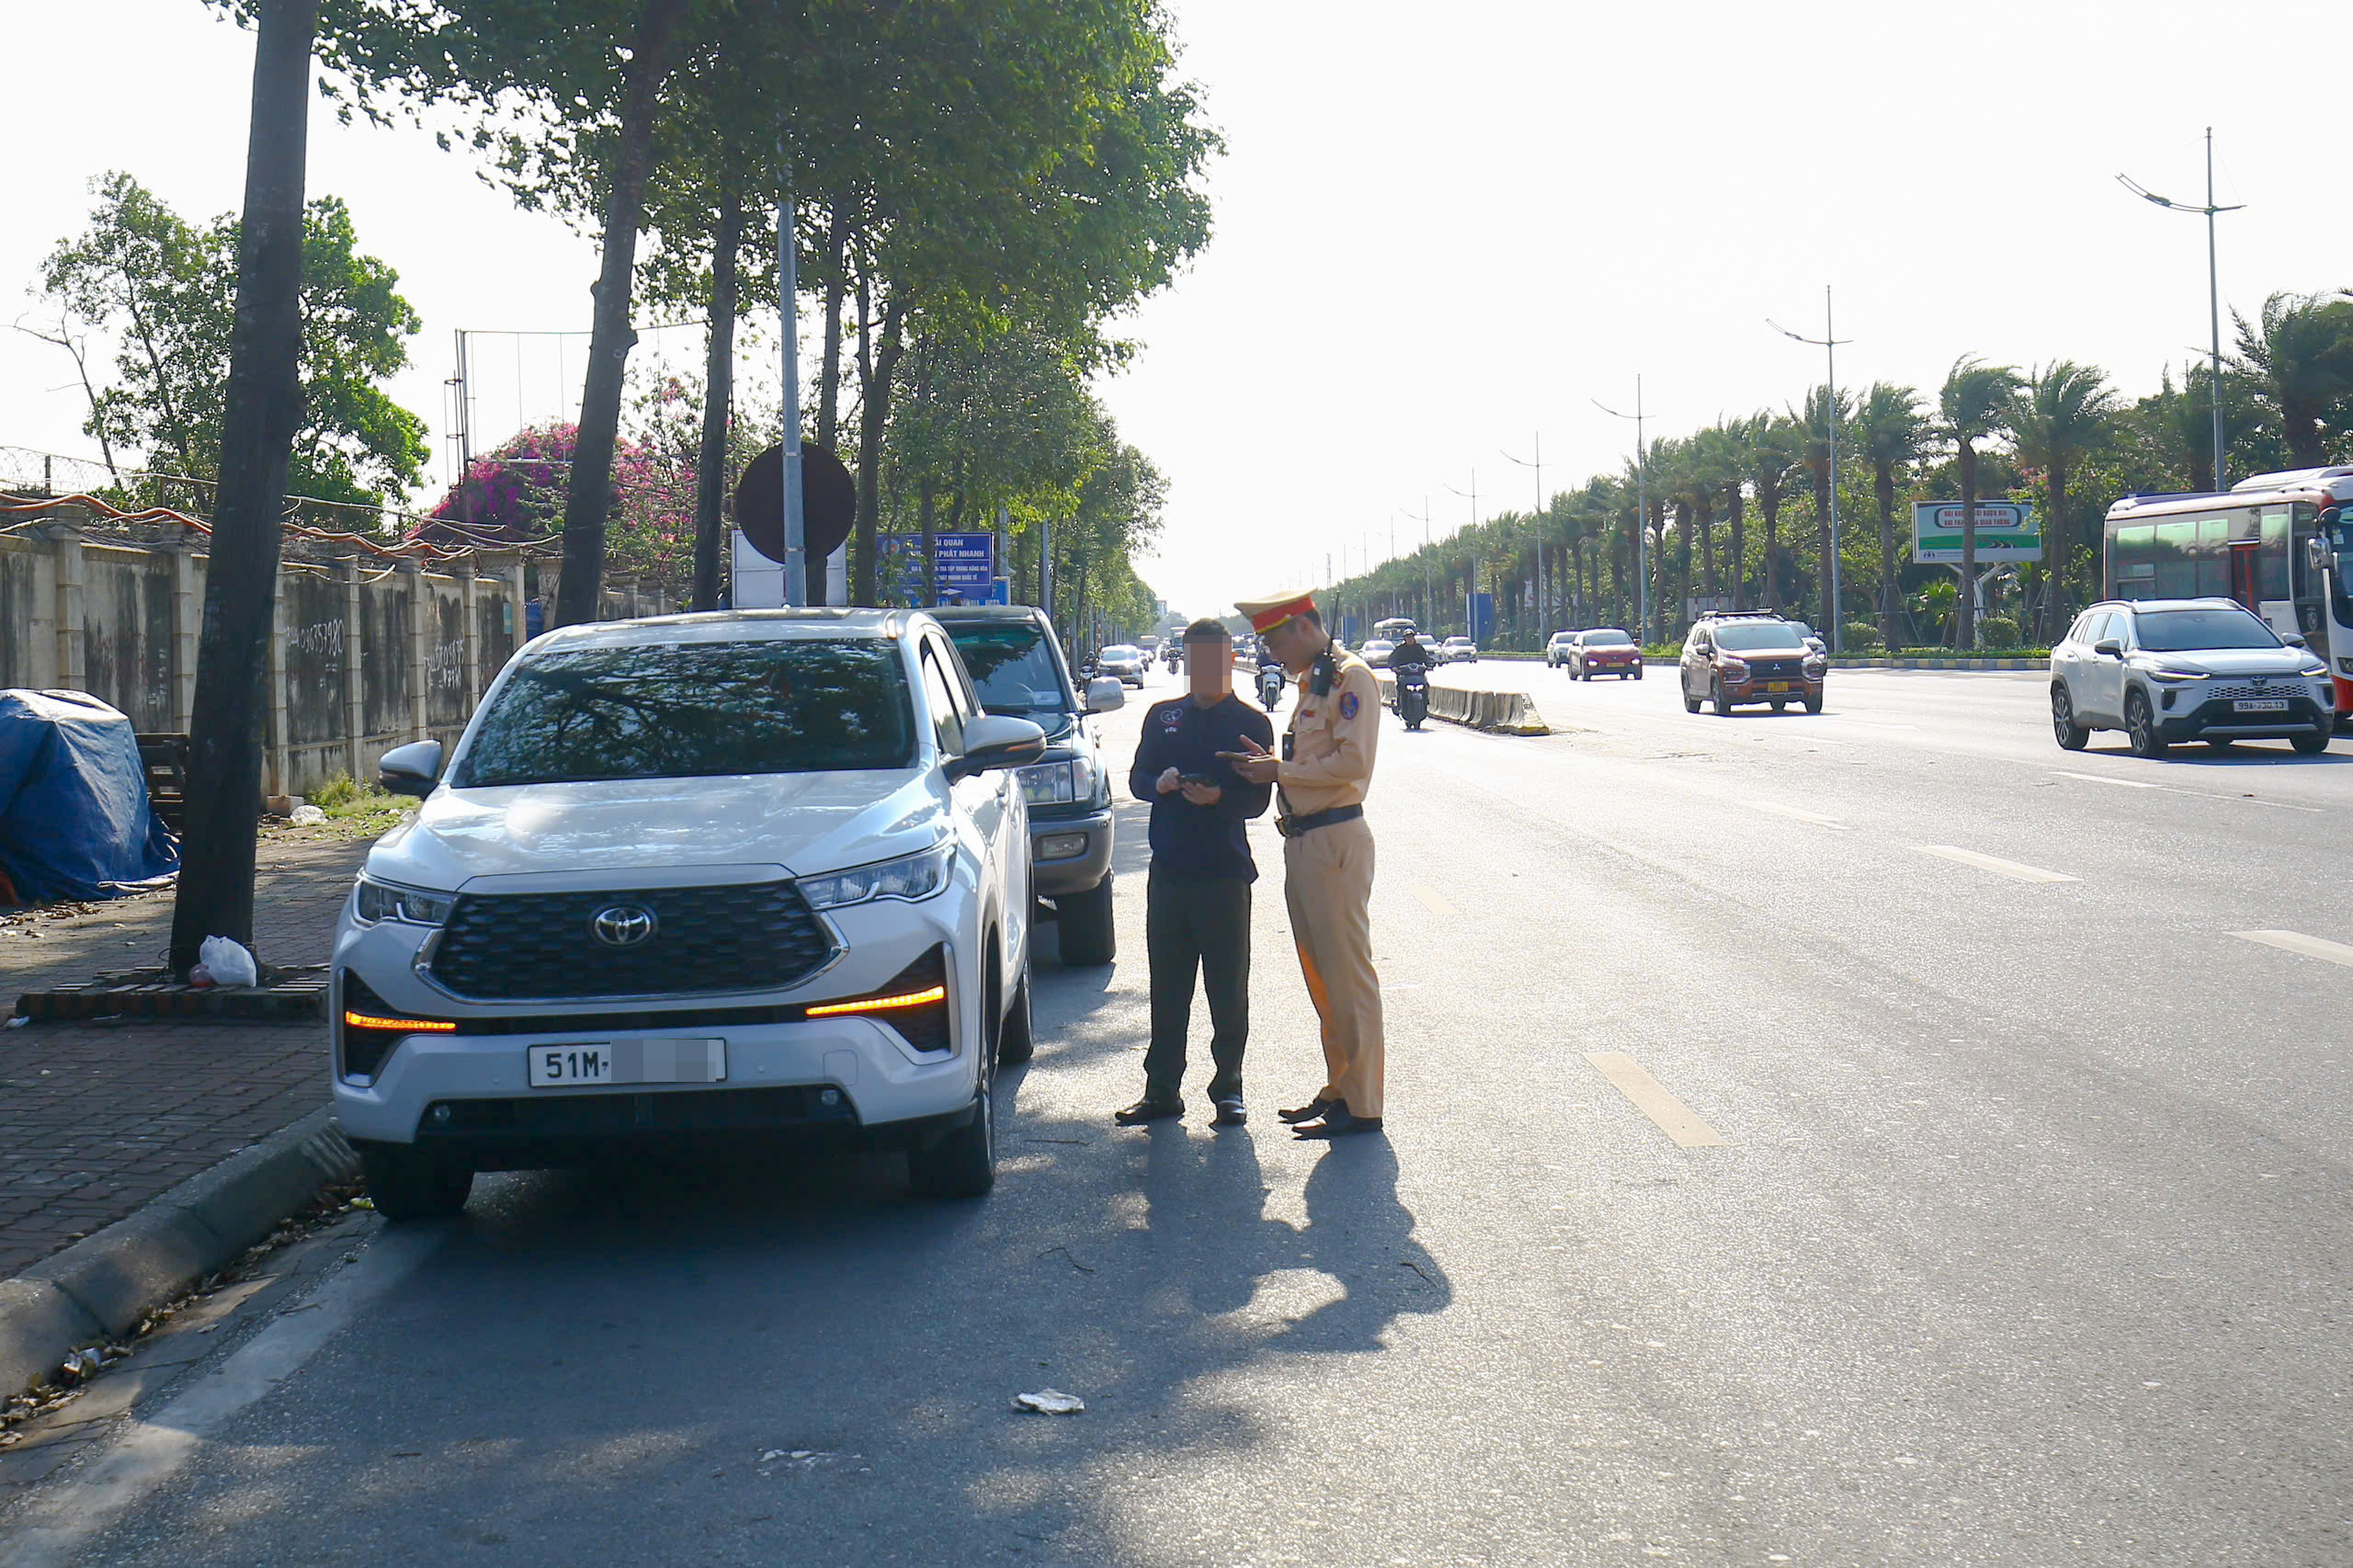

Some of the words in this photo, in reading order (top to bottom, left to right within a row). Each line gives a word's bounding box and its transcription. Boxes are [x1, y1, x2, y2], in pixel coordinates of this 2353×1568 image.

[943, 539, 964, 547] QUAN
[938, 549, 958, 558] PHÁT
[959, 550, 984, 558] NHANH
